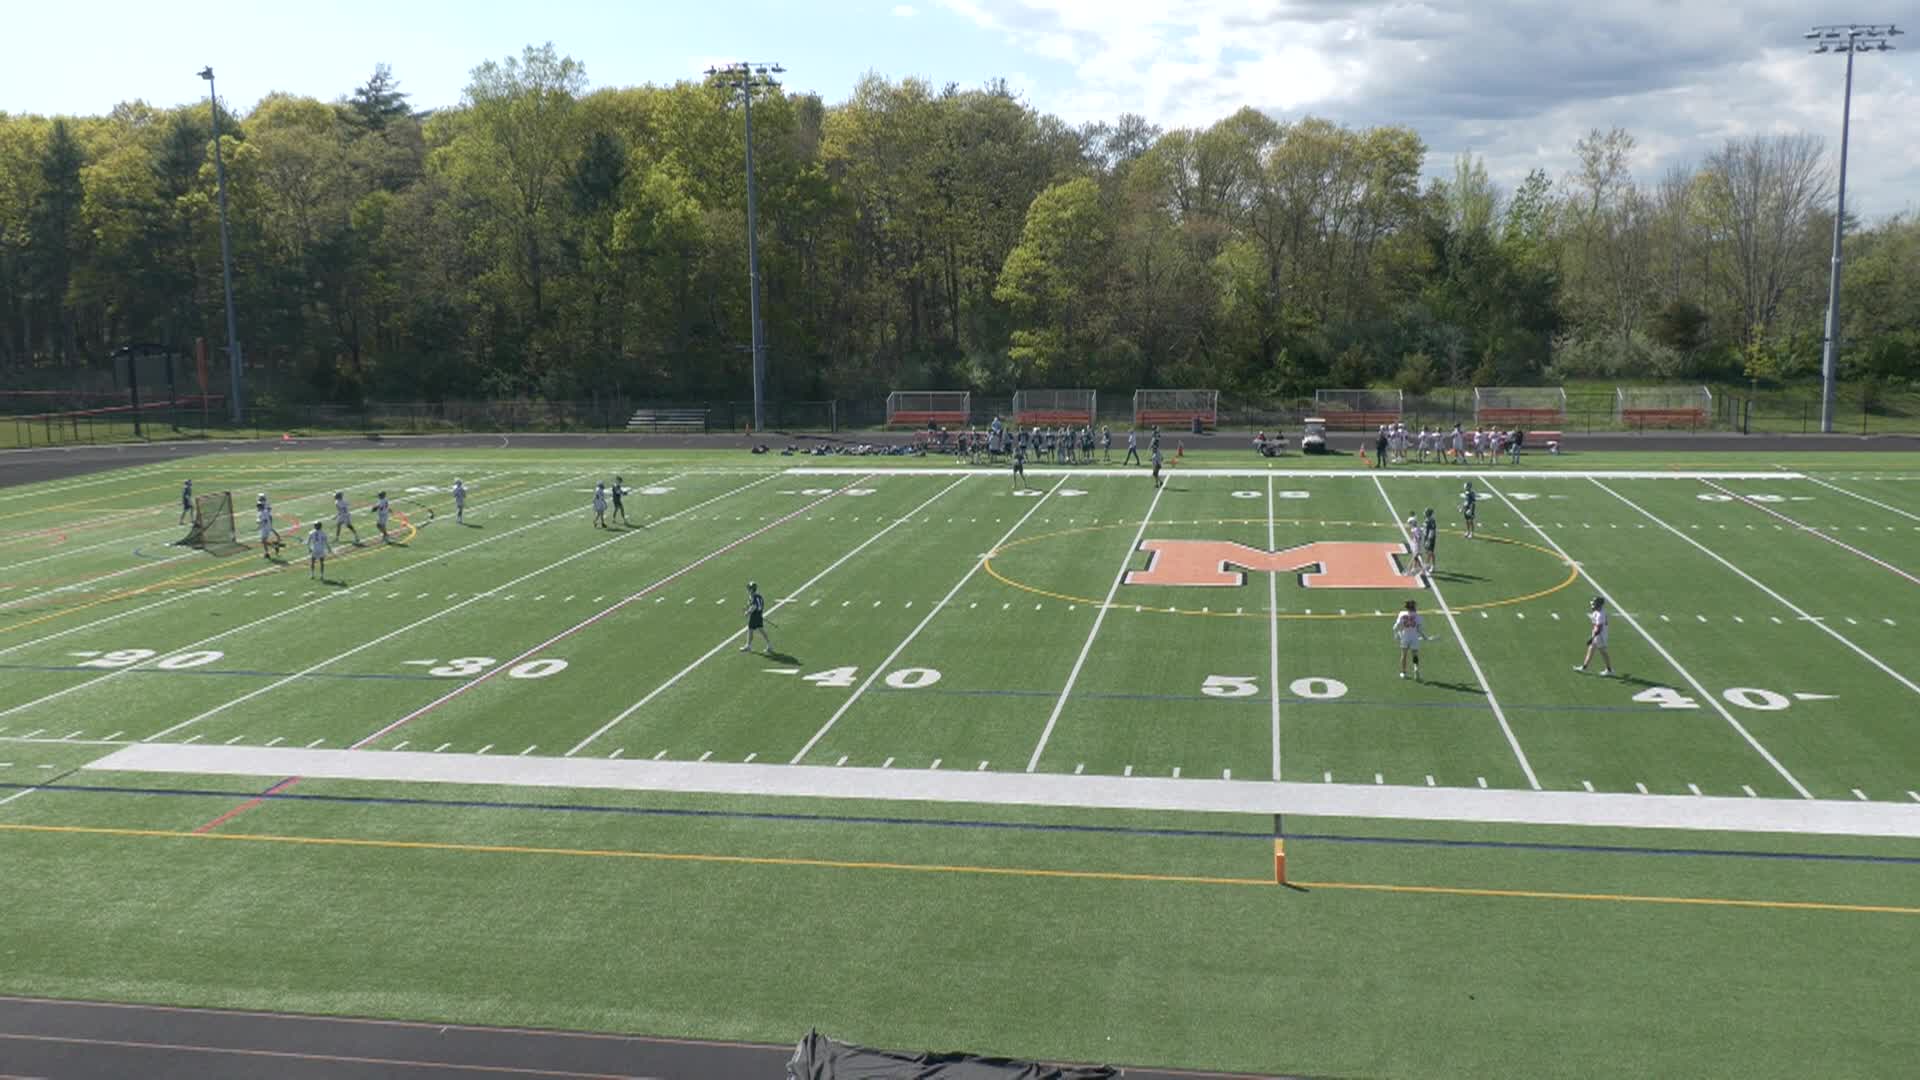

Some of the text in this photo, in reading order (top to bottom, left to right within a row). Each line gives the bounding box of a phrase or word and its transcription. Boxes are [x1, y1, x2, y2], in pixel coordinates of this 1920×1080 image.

[1123, 539, 1427, 588] M
[802, 666, 942, 688] 40
[1201, 675, 1348, 698] 50
[1632, 687, 1790, 710] 40
